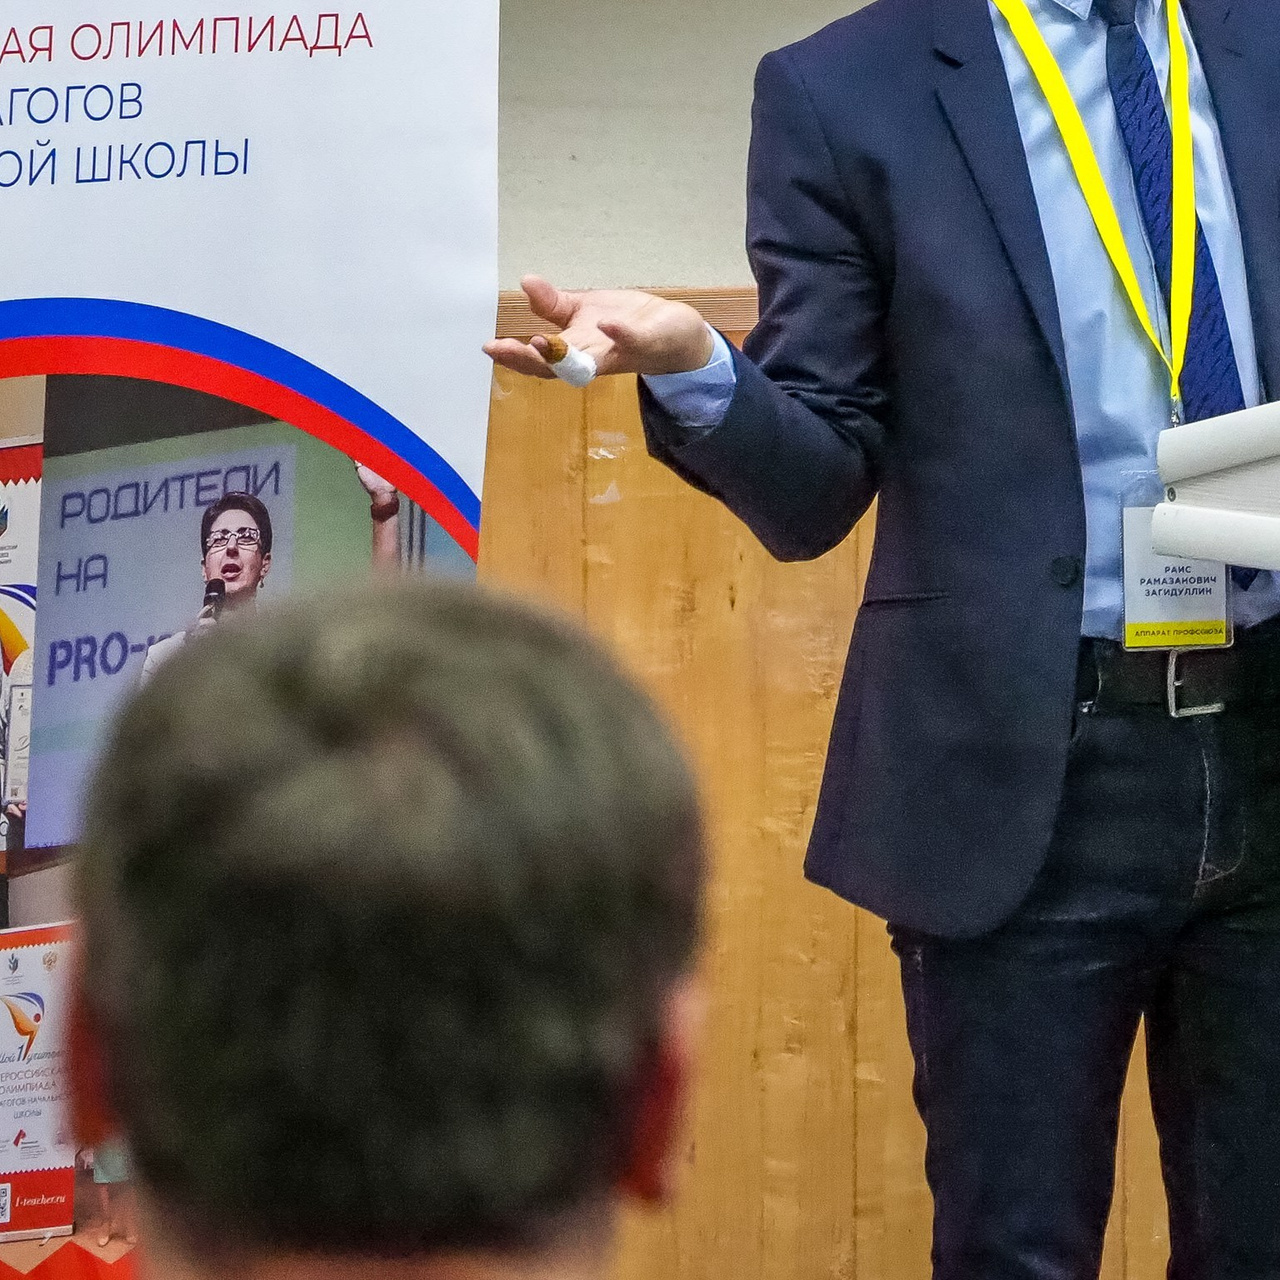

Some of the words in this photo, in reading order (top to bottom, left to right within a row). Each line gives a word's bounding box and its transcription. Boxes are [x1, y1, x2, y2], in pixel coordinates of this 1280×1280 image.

[70, 12, 374, 61] ОЛИМПИАДА
[0, 82, 144, 126] ГОГОВ
[75, 138, 249, 184] ШКОЛЫ
[60, 461, 280, 529] РОДИТЕЛИ
[55, 553, 108, 596] НА
[1140, 577, 1217, 586] РАМАЗАНОВИЧ
[1164, 566, 1192, 574] РАИС
[1145, 588, 1212, 597] ЗАГИДУЛЛИН
[1173, 628, 1224, 636] ПРОФСОЮЗА
